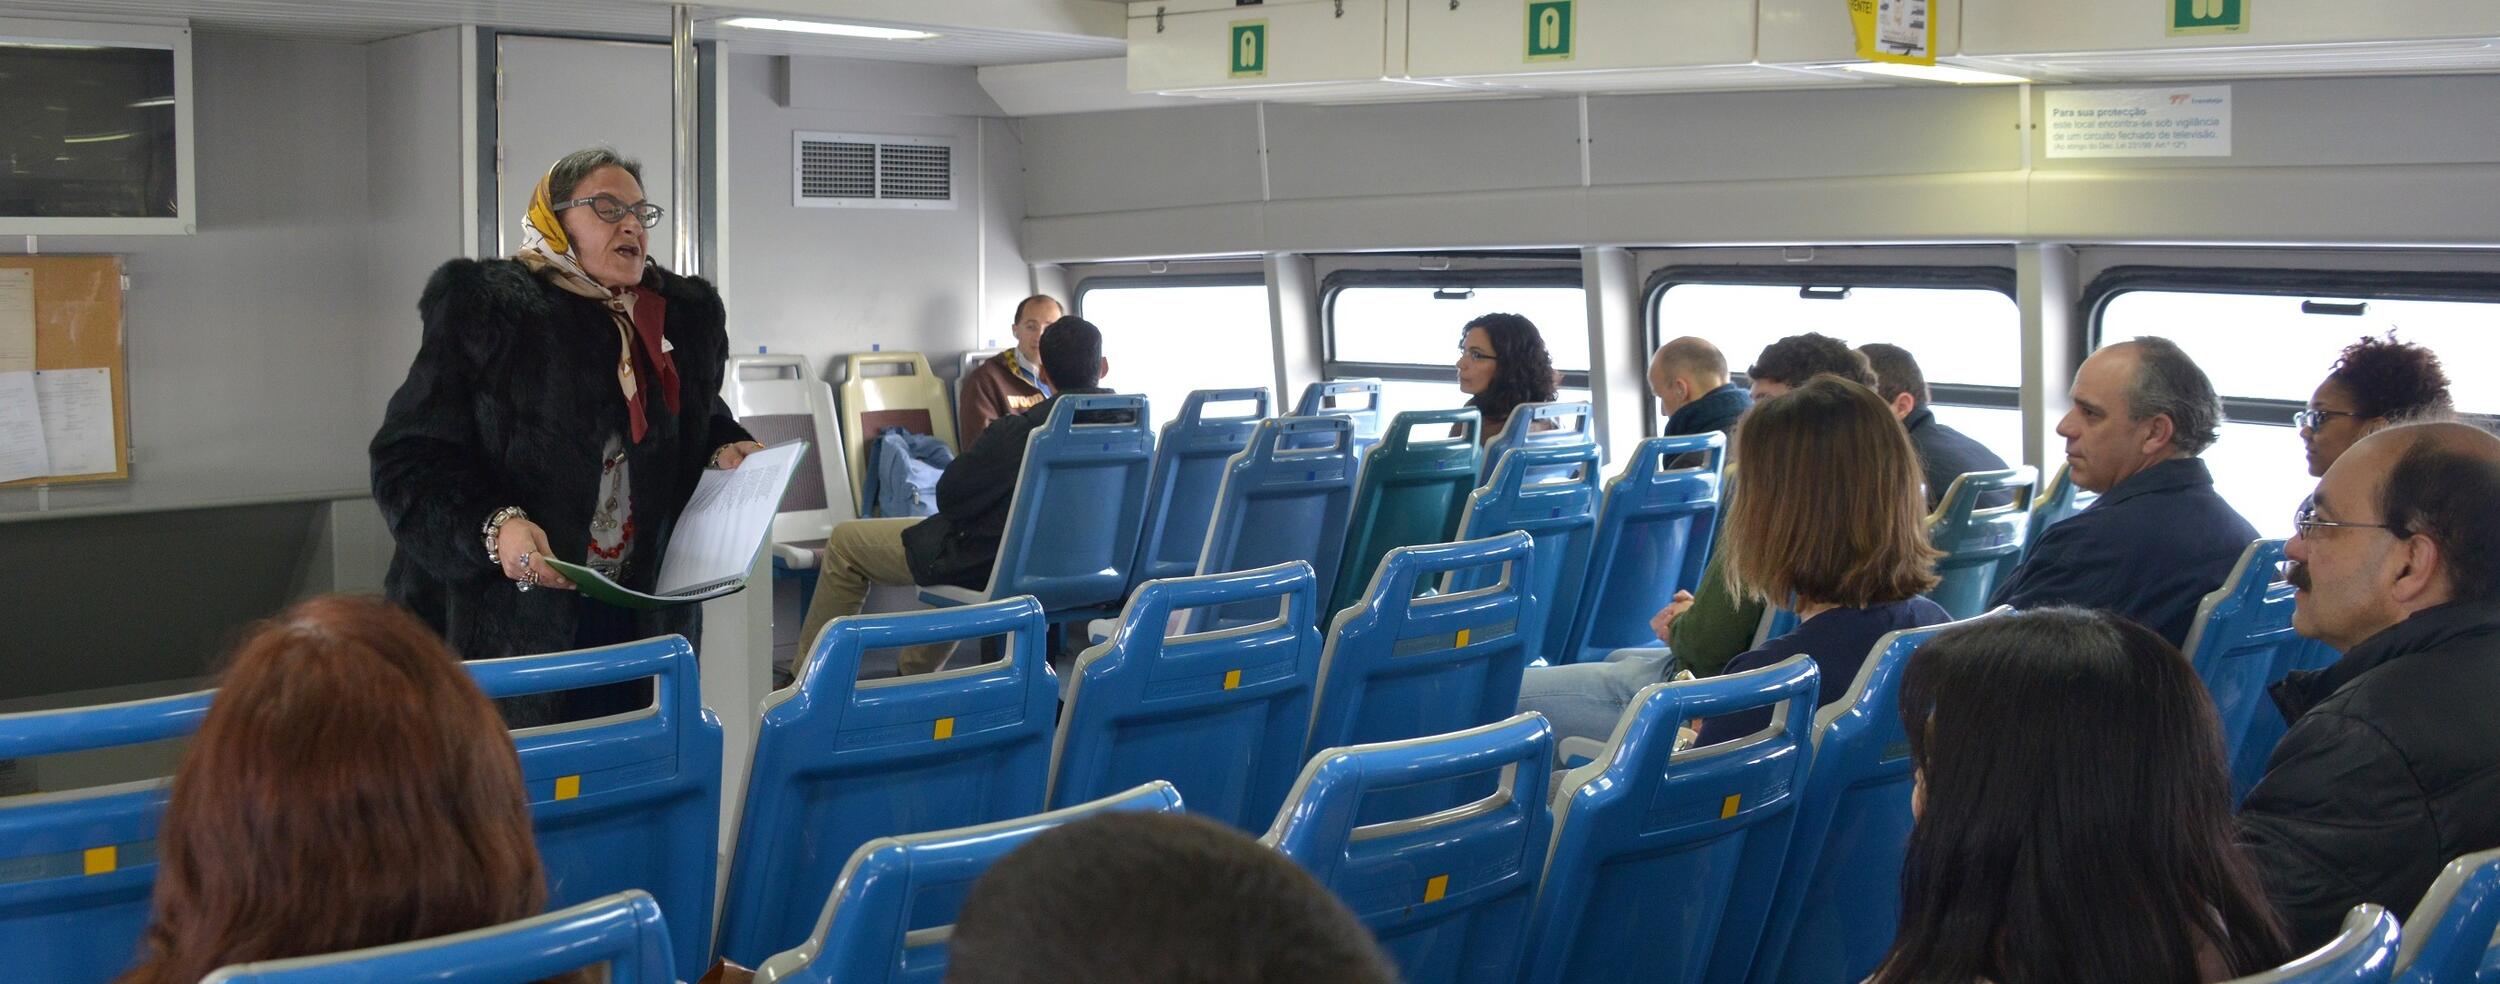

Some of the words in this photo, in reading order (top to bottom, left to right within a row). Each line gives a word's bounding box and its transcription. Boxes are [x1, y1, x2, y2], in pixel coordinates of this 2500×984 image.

[2052, 108, 2075, 117] Para
[2077, 109, 2095, 117] sua
[2097, 107, 2147, 119] protecção
[2052, 120, 2072, 129] este
[2074, 120, 2095, 129] local
[2097, 120, 2154, 129] encontra-se
[2155, 119, 2173, 128] sob
[2175, 117, 2220, 129] vigilância
[2052, 132, 2065, 141] de
[2083, 132, 2117, 141] circuito
[2118, 131, 2156, 140] fechado
[2157, 131, 2171, 140] de
